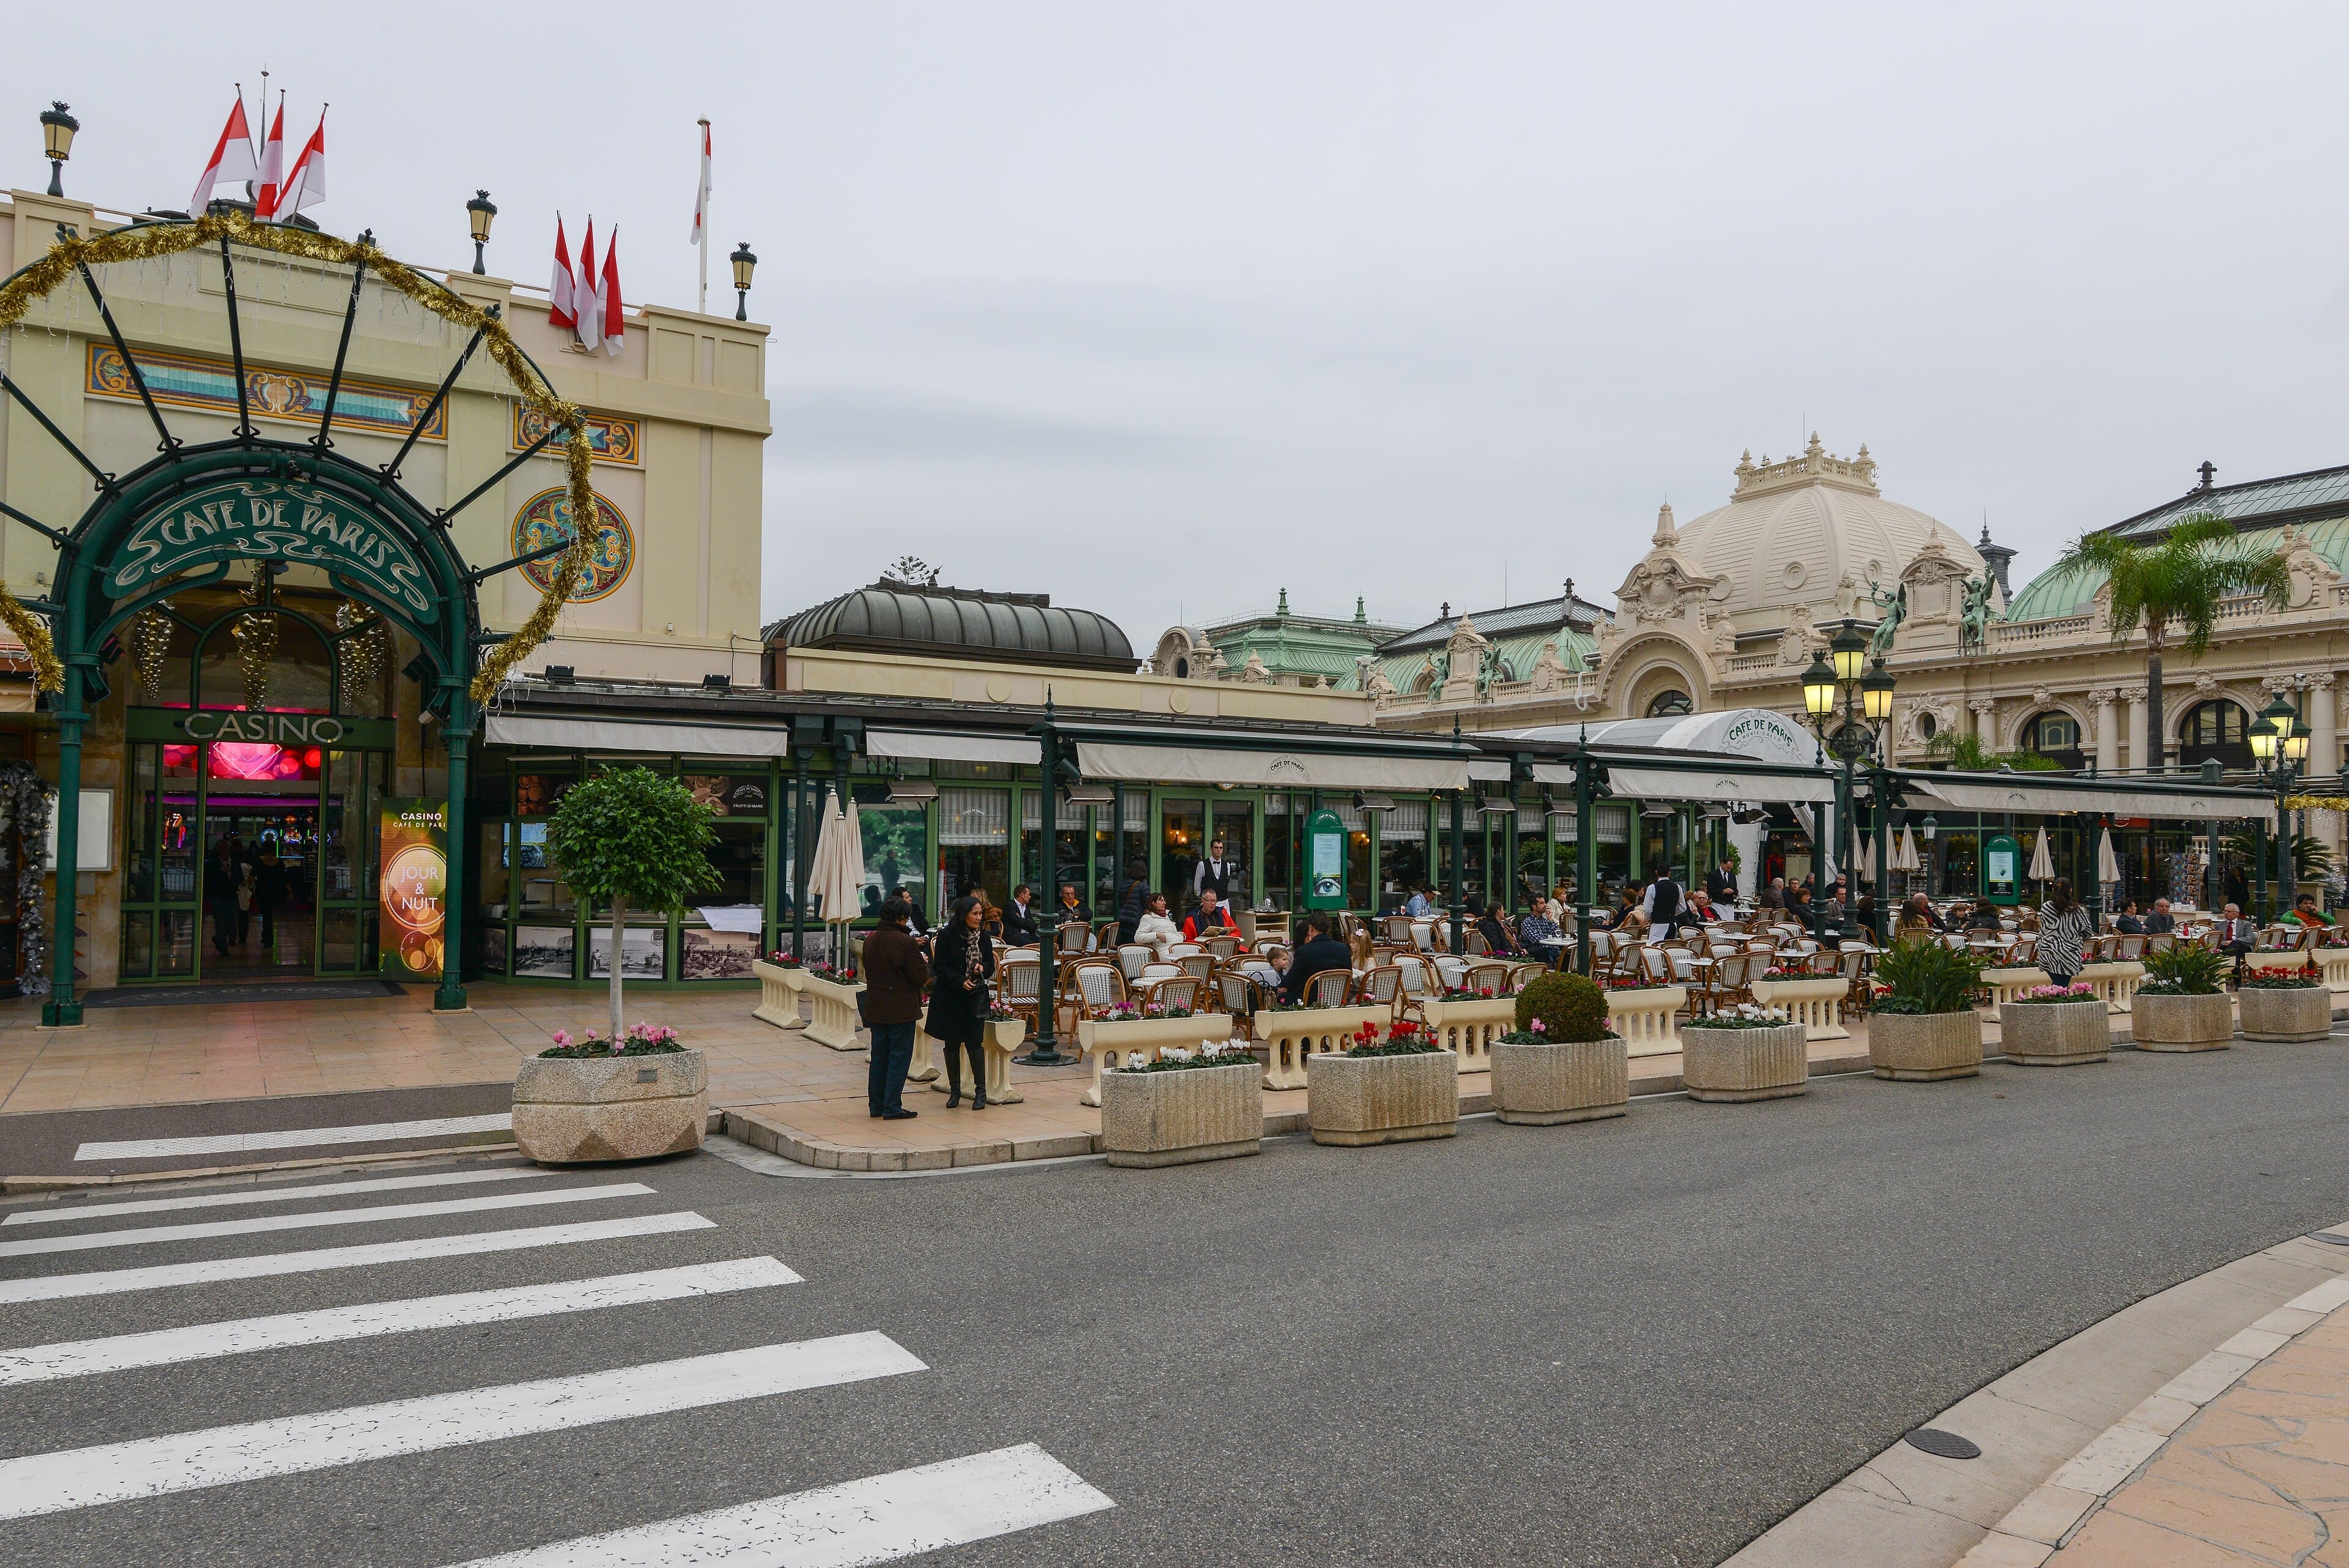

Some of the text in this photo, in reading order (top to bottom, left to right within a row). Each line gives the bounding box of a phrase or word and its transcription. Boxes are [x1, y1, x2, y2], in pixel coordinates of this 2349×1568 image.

[161, 499, 396, 568] CAFE DE PARIS
[185, 713, 344, 743] CASINO
[1729, 719, 1793, 747] CAFE DE PARIS
[1271, 761, 1283, 771] CAFE
[1291, 761, 1305, 773] PARIS
[401, 866, 439, 882] JOUR
[415, 882, 424, 894] &
[402, 897, 438, 910] NUIT
